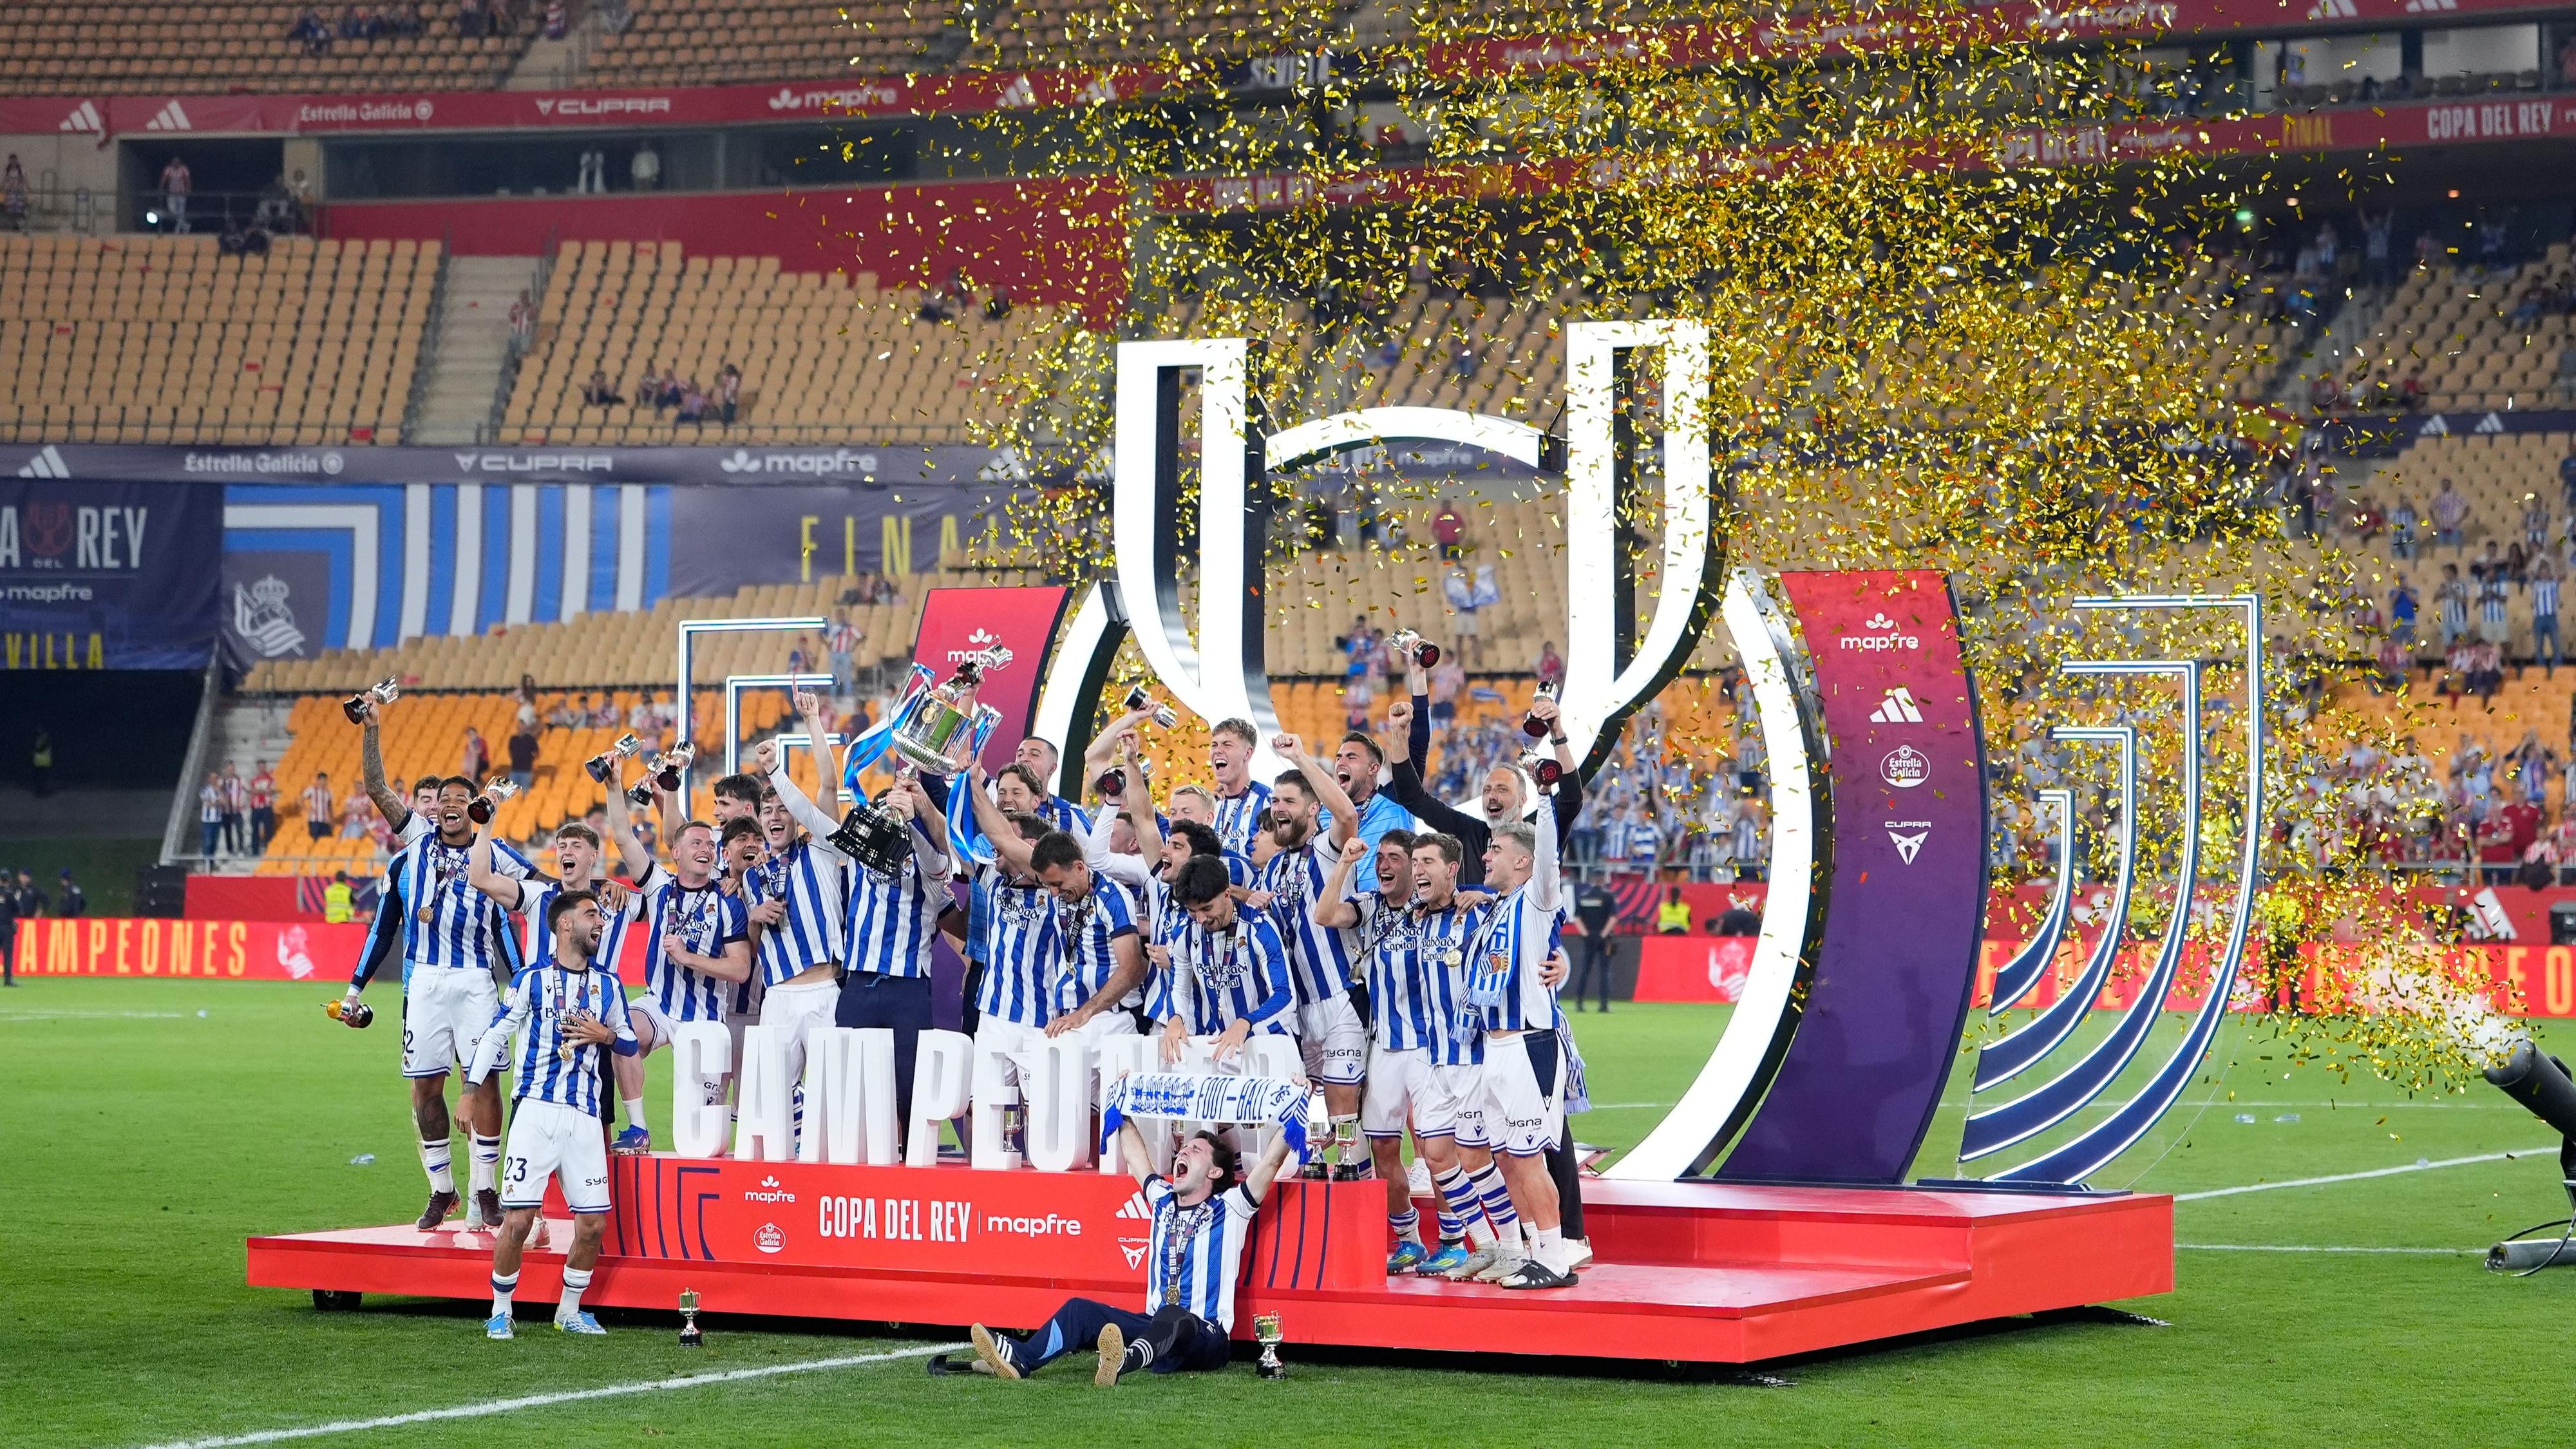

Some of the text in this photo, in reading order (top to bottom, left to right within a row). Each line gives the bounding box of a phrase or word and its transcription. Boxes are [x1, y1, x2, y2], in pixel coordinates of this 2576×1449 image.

[558, 98, 670, 114] CUPRA
[805, 84, 897, 110] mapfre
[300, 102, 412, 121] Estrella Galicia
[2427, 108, 2476, 138] COPA
[2481, 104, 2512, 135] DEL
[2519, 102, 2553, 133] REY
[184, 453, 317, 473] Estrella Galicia
[480, 454, 613, 471] CUPRA
[766, 450, 877, 477] mapfre
[77, 506, 147, 568] REY
[6, 583, 93, 603] mapfre
[1841, 632, 1918, 652] mapfre
[1889, 757, 1922, 769] Estrella
[1889, 766, 1920, 779] Galicia
[19, 921, 247, 976] AMPEONES
[1383, 940, 1415, 952] Capital
[504, 1156, 527, 1182] 23
[745, 1190, 795, 1204] mapfre
[820, 1196, 1081, 1242] COPA DEL REY mapfre
[759, 1231, 781, 1240] Estrella
